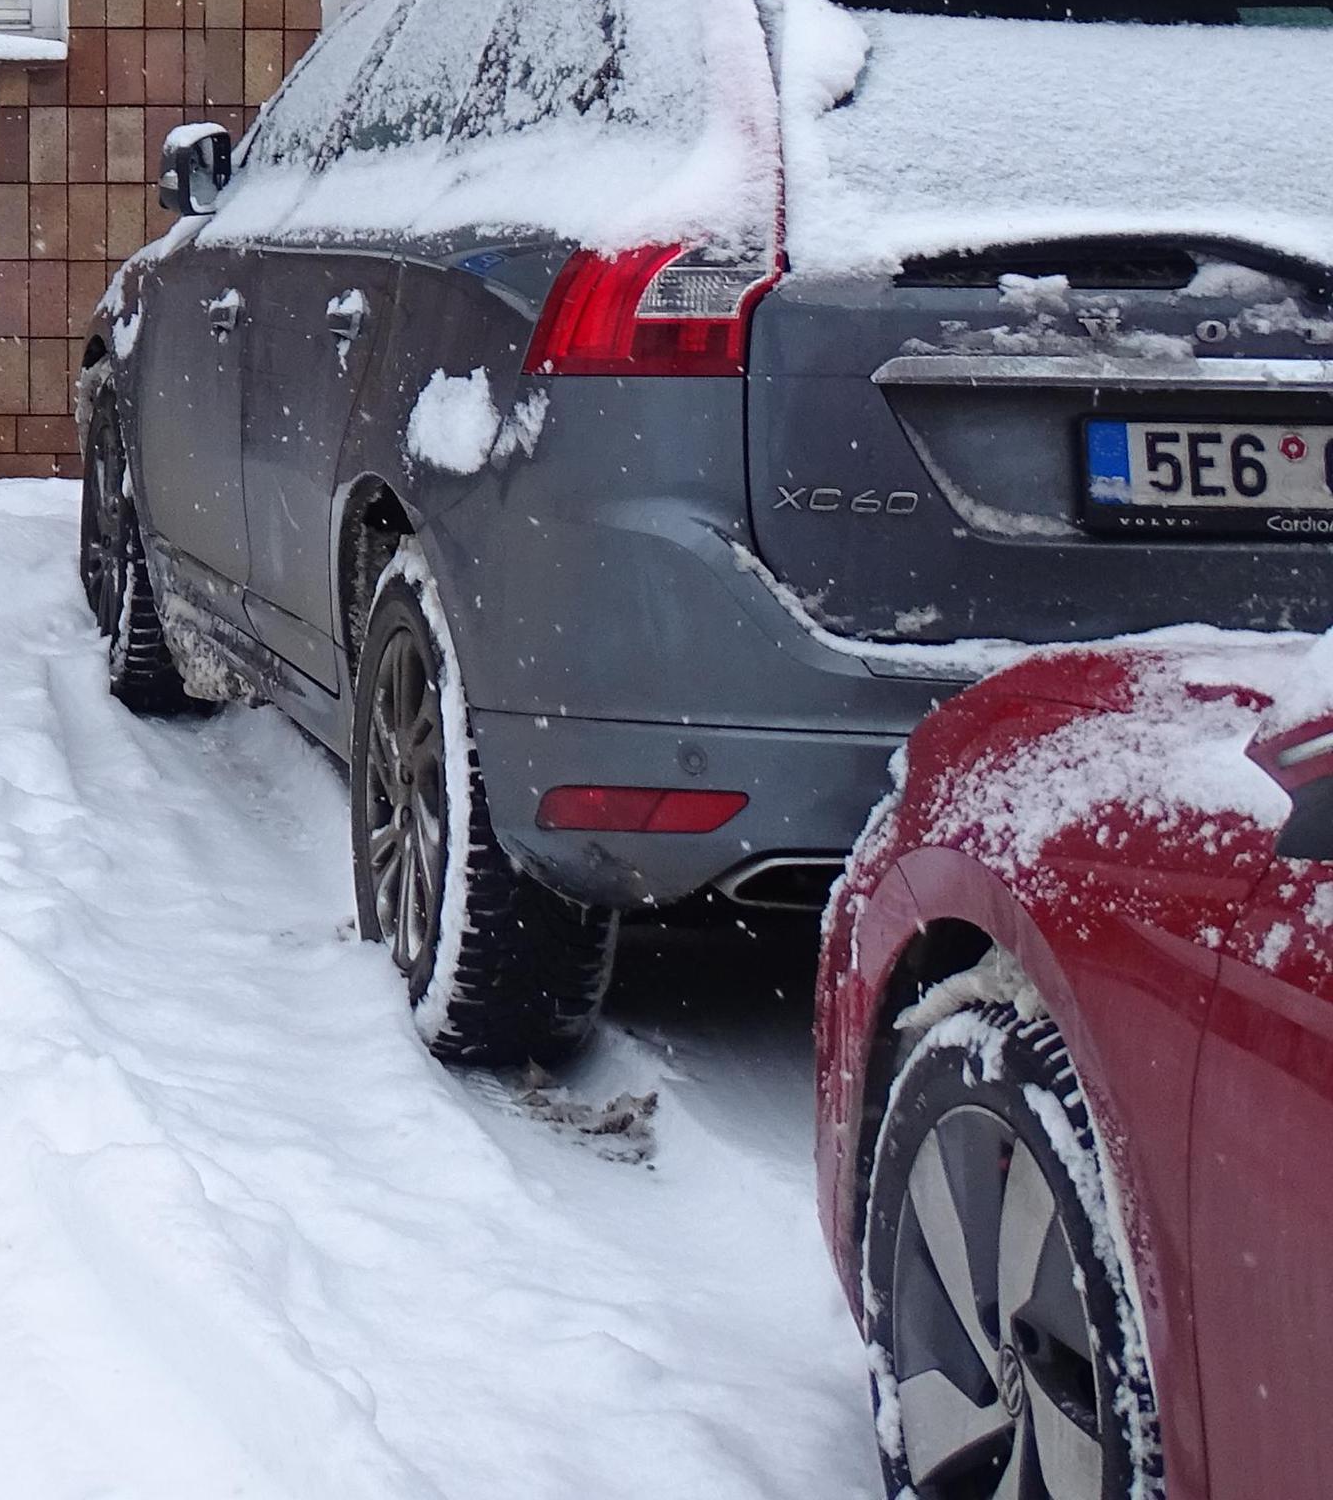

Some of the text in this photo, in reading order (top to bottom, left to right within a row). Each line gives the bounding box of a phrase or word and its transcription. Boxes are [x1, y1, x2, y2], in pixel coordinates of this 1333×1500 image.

[773, 486, 918, 514] XC60
[1119, 518, 1191, 526] VOLVO
[1266, 515, 1333, 532] Cardio
